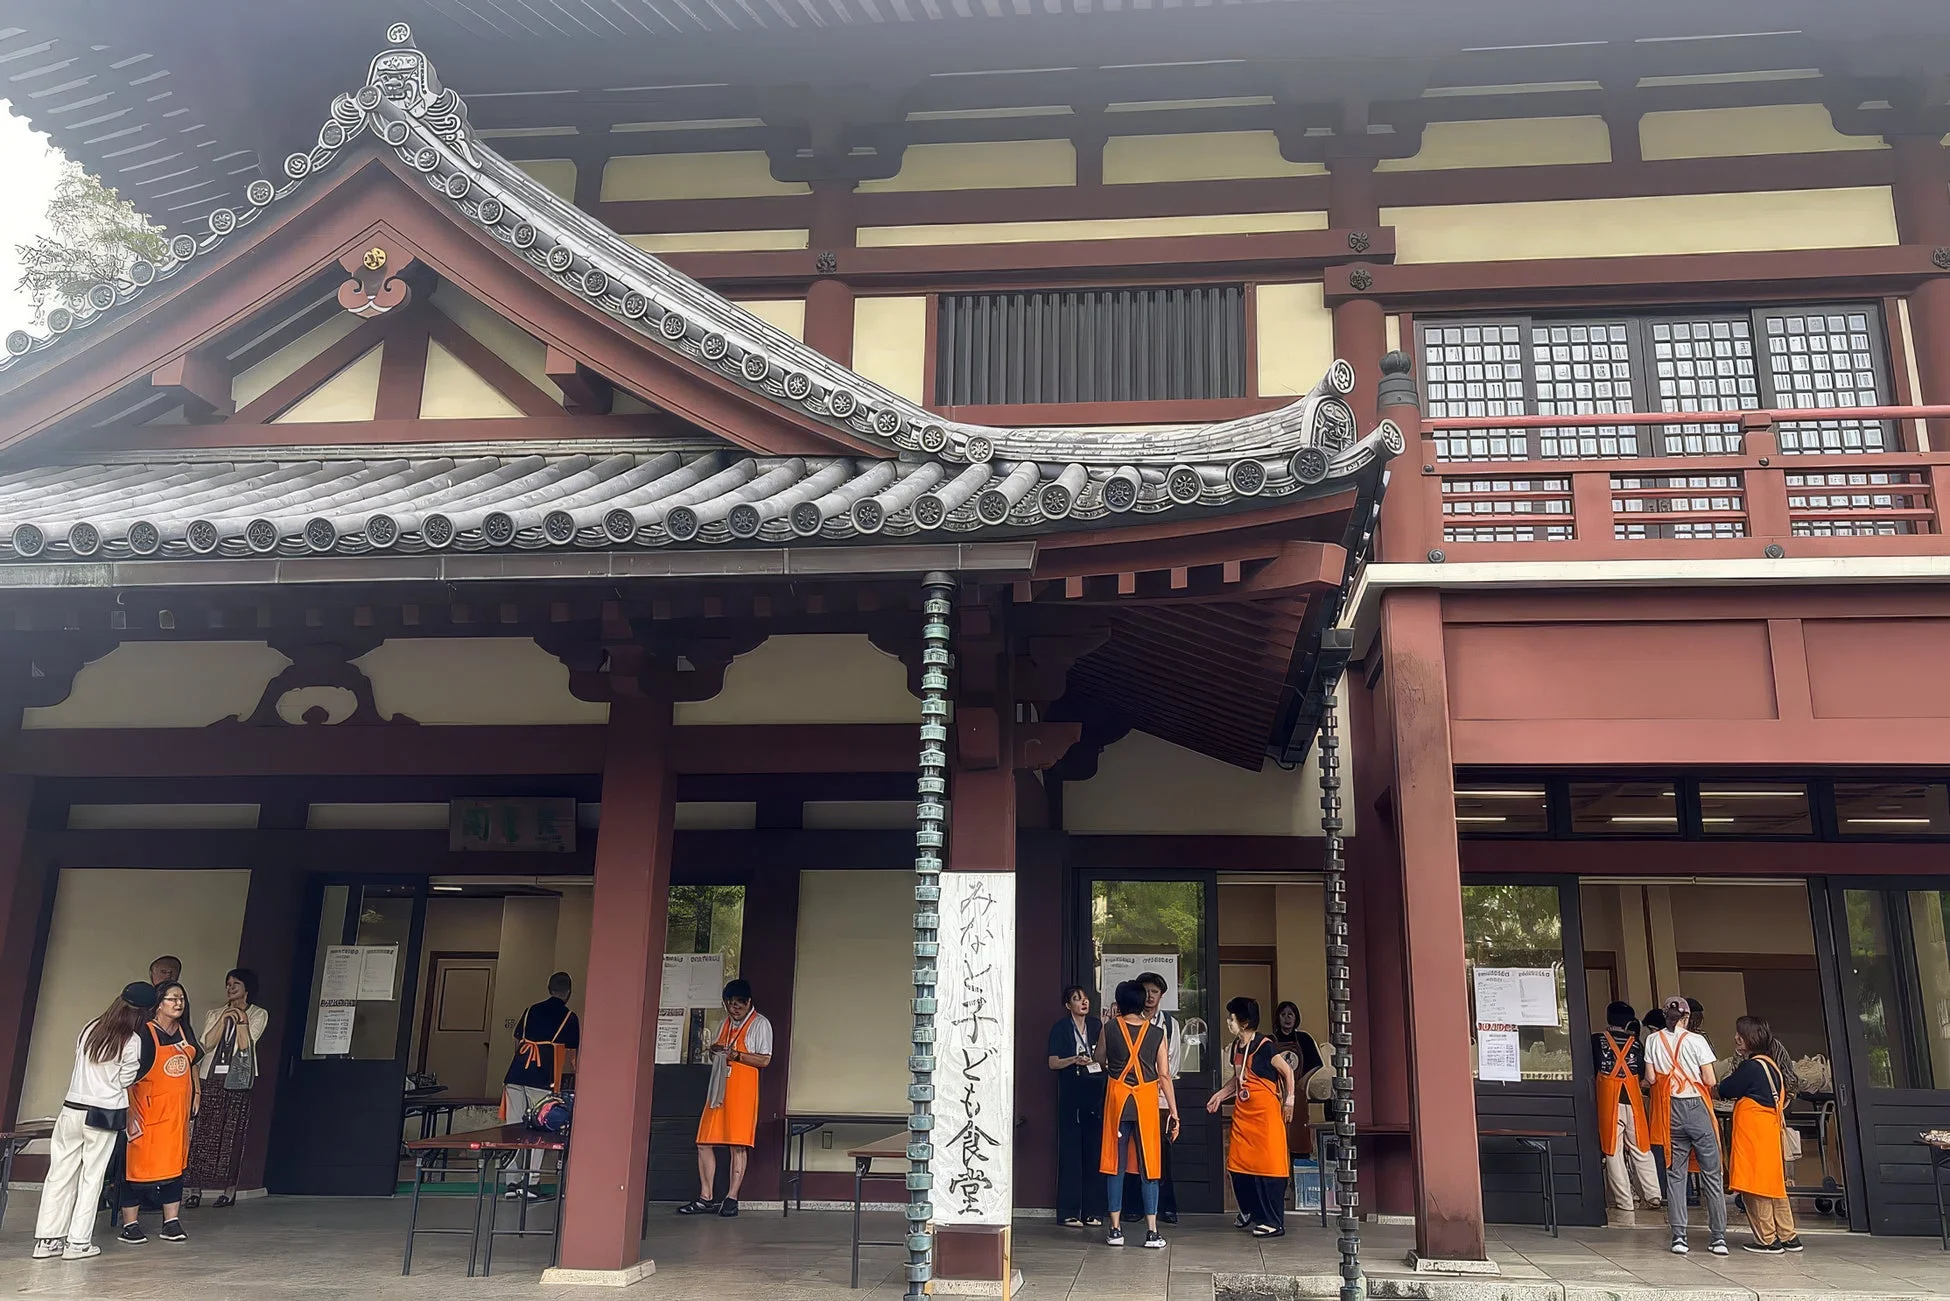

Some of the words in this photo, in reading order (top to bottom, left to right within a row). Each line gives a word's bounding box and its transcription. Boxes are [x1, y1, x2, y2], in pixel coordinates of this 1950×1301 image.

[946, 880, 1001, 1216] みなと子ども食堂
